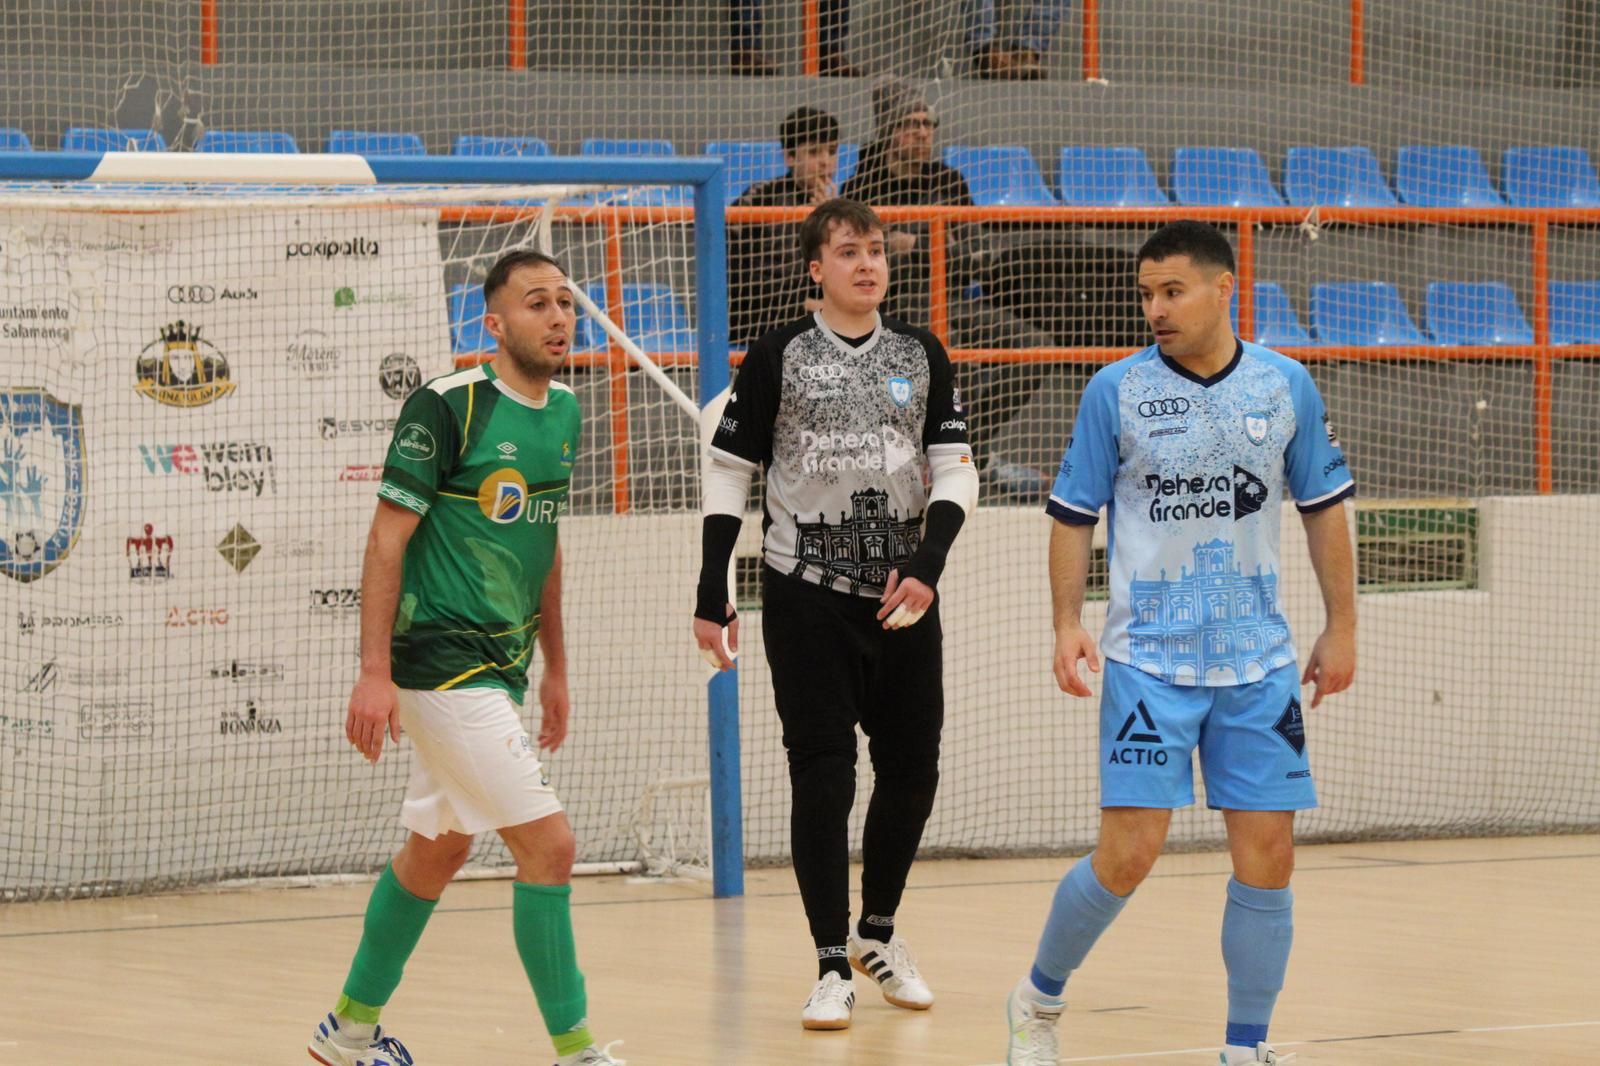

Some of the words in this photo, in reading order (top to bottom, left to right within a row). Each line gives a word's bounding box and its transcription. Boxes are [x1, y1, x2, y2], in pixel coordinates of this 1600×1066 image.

[800, 430, 881, 451] Dehesa
[802, 450, 882, 473] Grande
[1145, 473, 1230, 497] Dehesa
[1149, 495, 1231, 522] Grande
[1109, 748, 1168, 766] ACTIO
